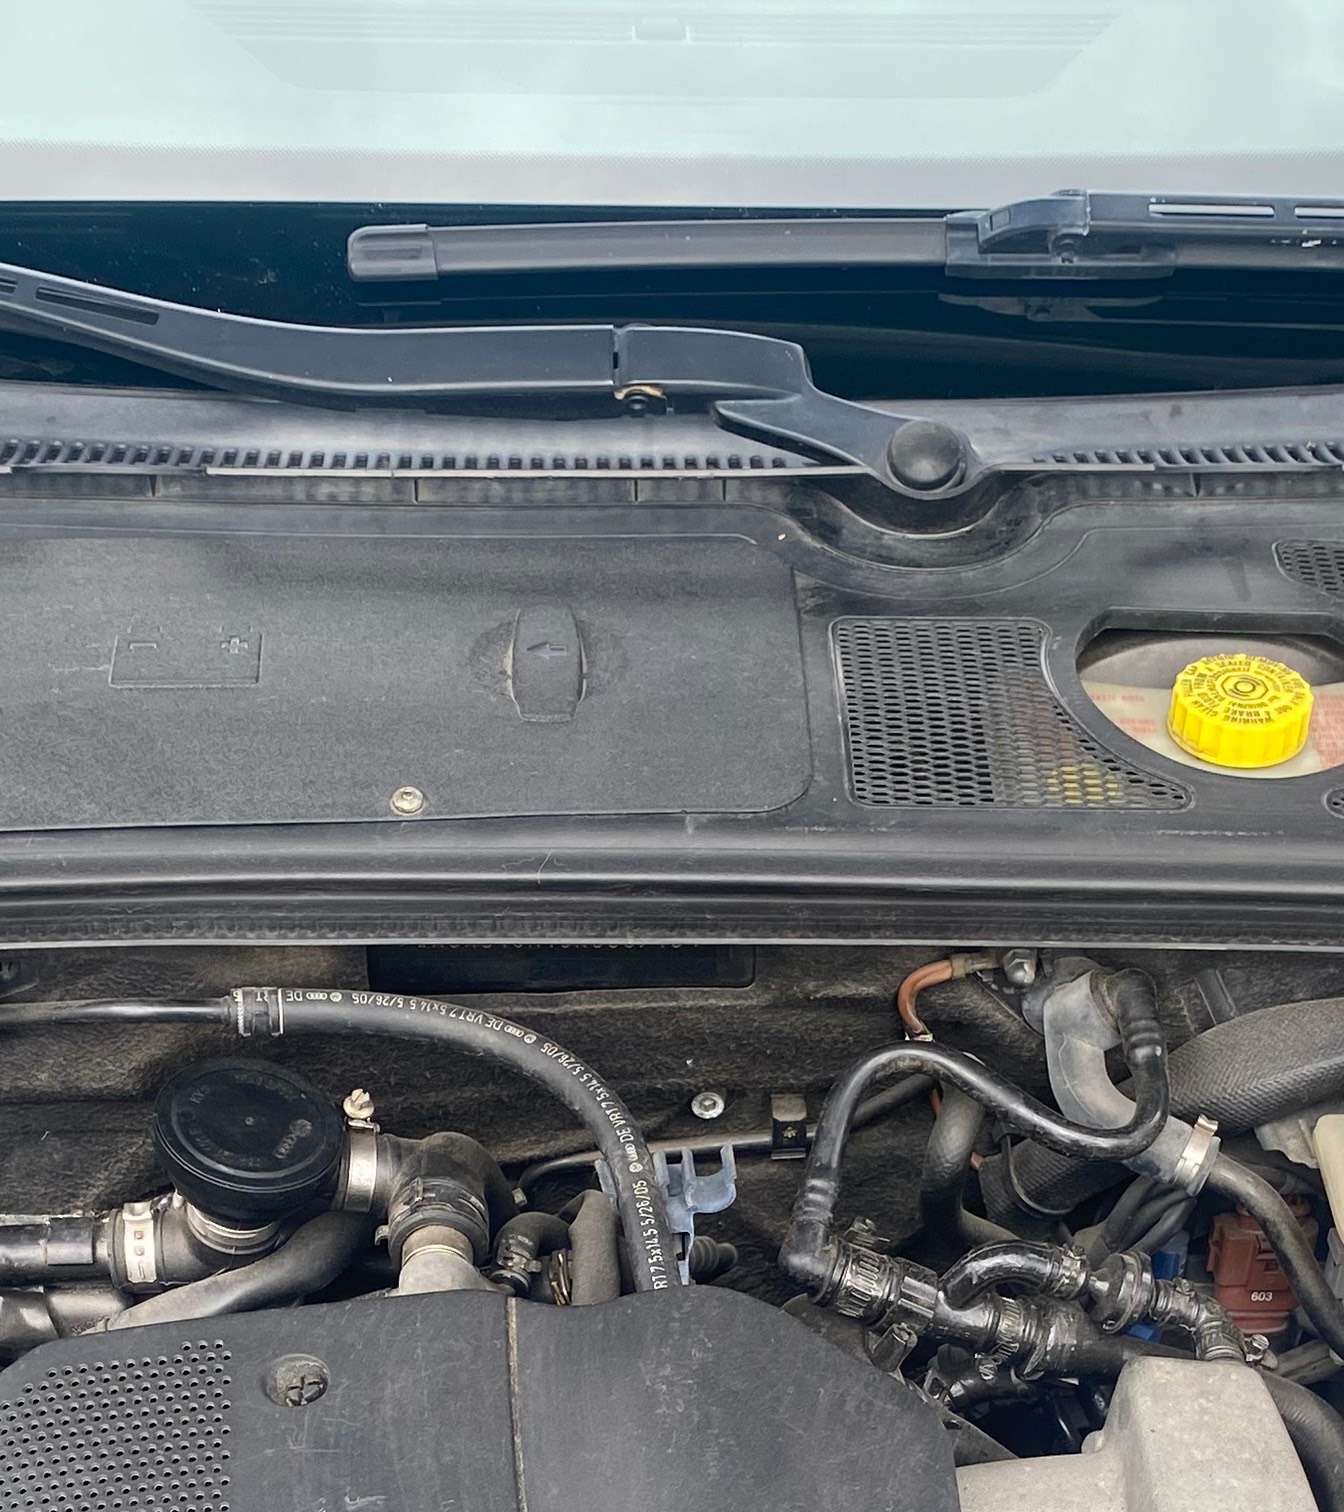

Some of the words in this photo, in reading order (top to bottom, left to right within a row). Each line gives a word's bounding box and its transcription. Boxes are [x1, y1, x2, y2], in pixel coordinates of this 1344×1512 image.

[540, 1042, 585, 1076] 5/26/05
[632, 1180, 655, 1227] 5/26/05
[1250, 1291, 1273, 1302] 603
